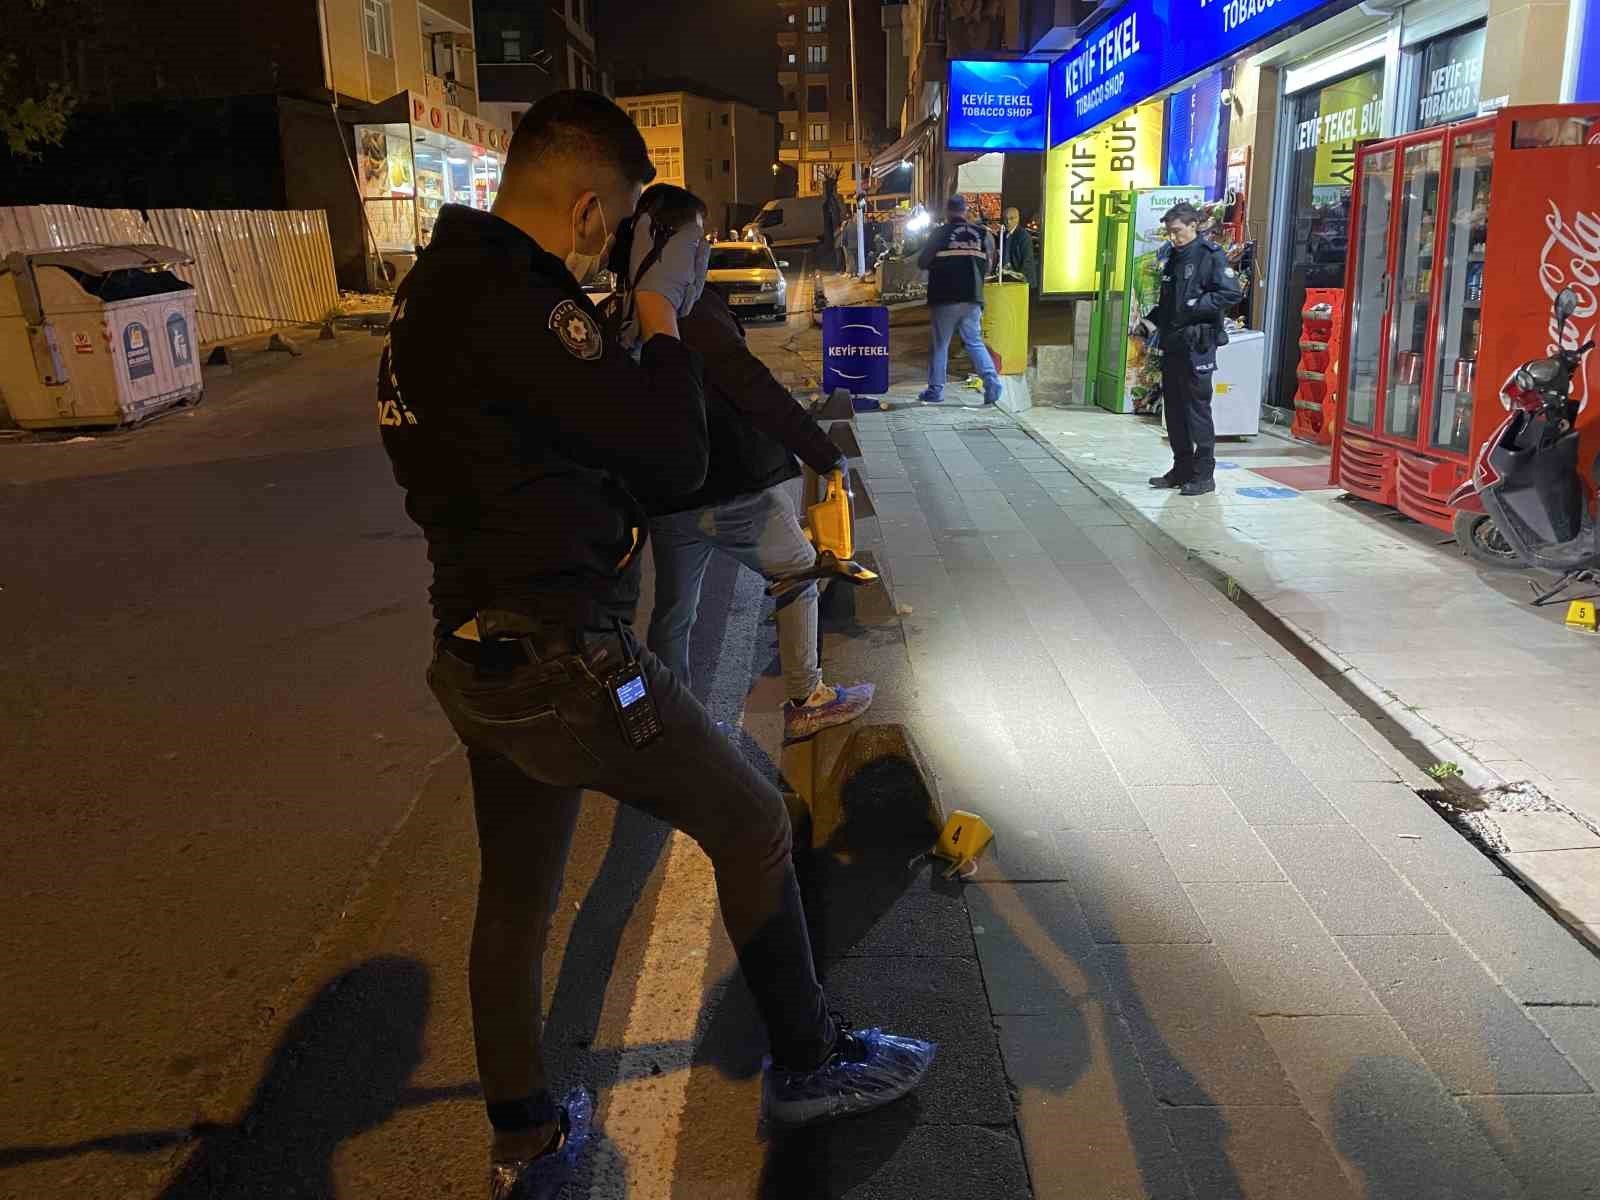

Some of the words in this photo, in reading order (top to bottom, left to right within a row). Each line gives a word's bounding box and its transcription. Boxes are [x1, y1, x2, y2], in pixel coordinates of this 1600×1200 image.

[1223, 0, 1283, 33] TOBA
[1065, 40, 1096, 99] KEYİF
[1099, 12, 1140, 75] TEKEL
[961, 92, 995, 105] KEYİF
[998, 94, 1033, 106] TEKEL
[962, 106, 1005, 117] TOBACCO
[1007, 108, 1033, 117] SHOP
[1076, 84, 1104, 119] TOBACCO
[1105, 71, 1125, 100] SHOP
[1420, 86, 1471, 121] TOBACCO
[1324, 106, 1358, 144] TEKEL
[1104, 119, 1137, 172] BÜF
[1065, 143, 1097, 224] KEYİF
[828, 344, 857, 356] KEYİF
[858, 346, 889, 356] TEKEL
[1579, 607, 1586, 619] 5
[951, 825, 963, 845] 4
